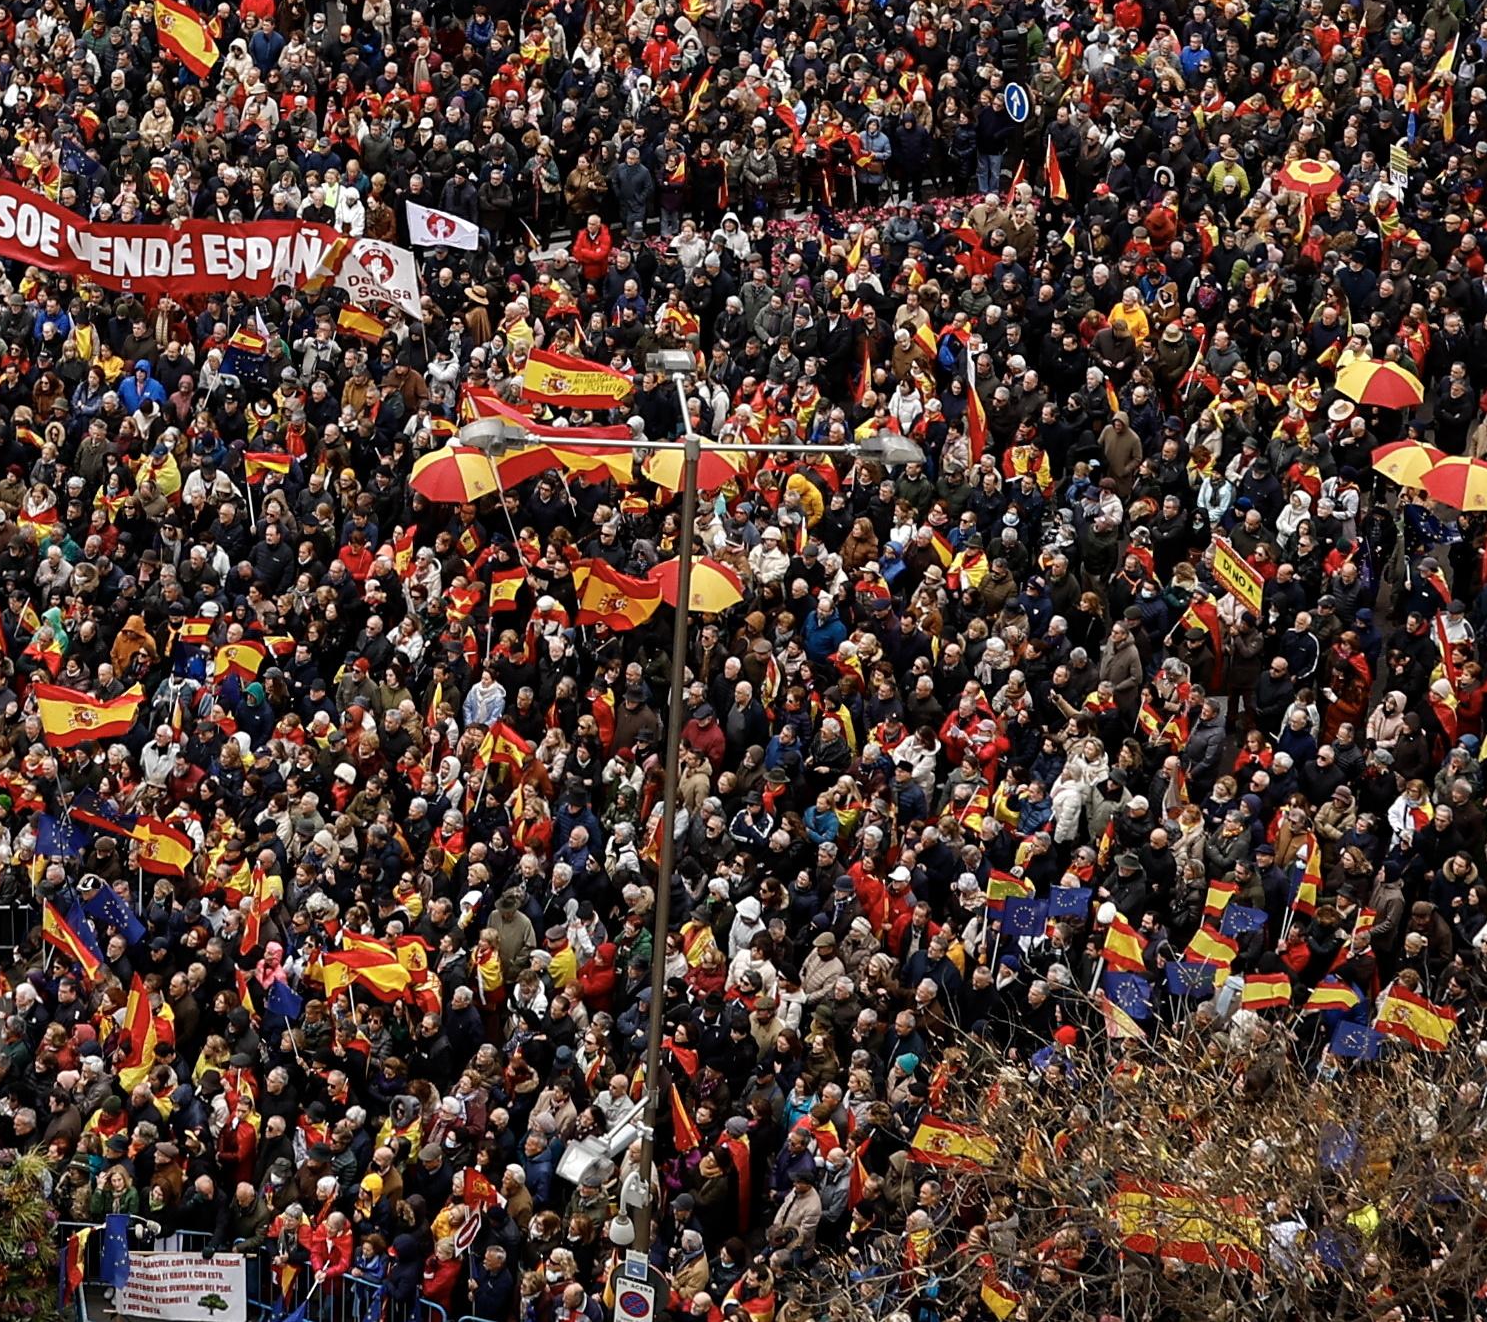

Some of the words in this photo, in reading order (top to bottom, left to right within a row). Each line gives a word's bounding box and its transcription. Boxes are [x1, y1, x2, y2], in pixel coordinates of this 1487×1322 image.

[1390, 170, 1407, 184] NO
[67, 223, 195, 278] VENDE
[1232, 571, 1246, 588] NO
